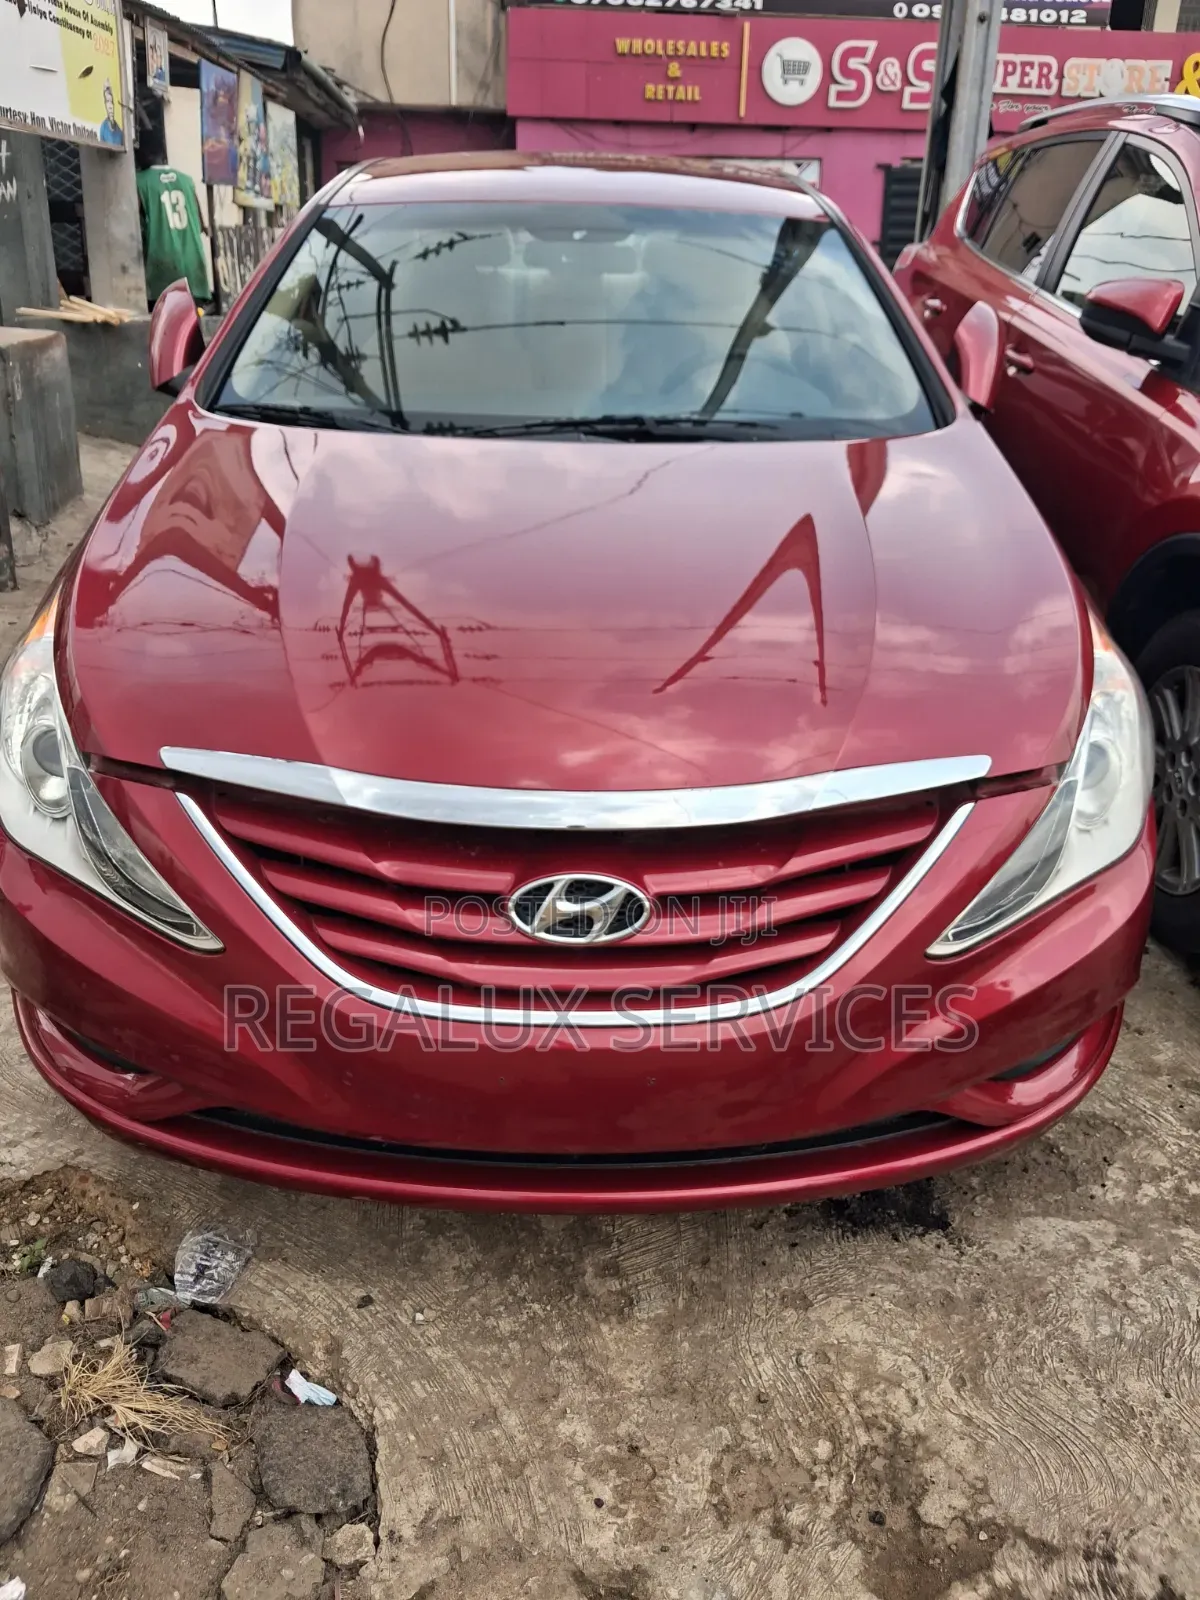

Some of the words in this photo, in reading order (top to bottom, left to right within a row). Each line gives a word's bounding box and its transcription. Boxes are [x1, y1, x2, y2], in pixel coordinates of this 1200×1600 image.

[48, 10, 85, 39] Constituency
[64, 1, 81, 20] House
[90, 14, 113, 36] Assembly
[614, 37, 730, 58] WHOLESALES
[667, 61, 682, 78] &
[993, 56, 1055, 93] PER
[1063, 59, 1171, 96] STORE
[644, 82, 702, 101] RETAIL
[48, 116, 71, 136] Victor
[160, 189, 188, 230] 13
